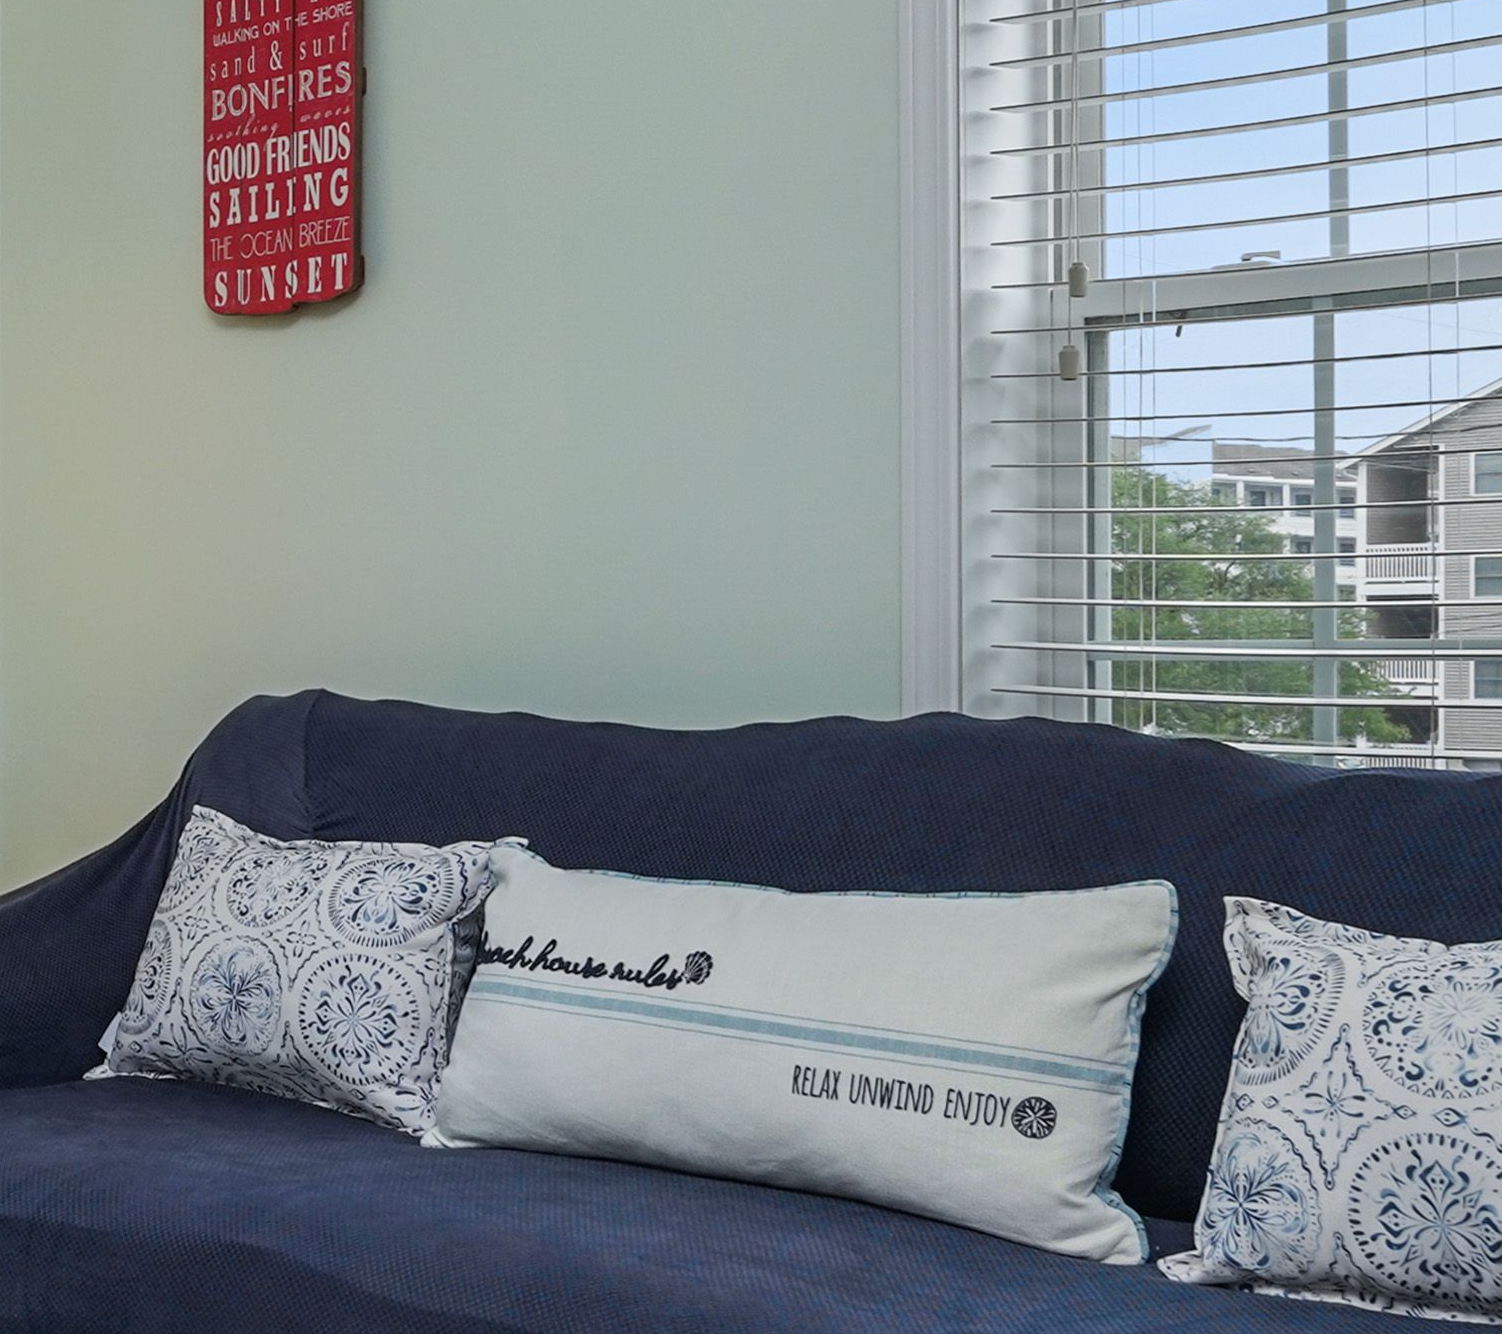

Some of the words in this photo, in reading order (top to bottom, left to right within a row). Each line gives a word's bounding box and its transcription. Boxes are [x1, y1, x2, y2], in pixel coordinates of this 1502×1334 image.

[209, 46, 256, 81] sand
[269, 40, 283, 71] &
[299, 22, 350, 61] surf
[212, 24, 259, 47] WALKING
[262, 21, 280, 37] ON
[284, 11, 308, 31] THE
[312, 1, 354, 25] SHORE
[210, 61, 352, 121] BONFIRES
[206, 141, 260, 185] GOOD
[266, 121, 351, 175] FRIENDS
[209, 167, 349, 229] SAILING
[210, 236, 234, 262] THE
[240, 227, 293, 259] OCEAN
[299, 216, 351, 248] BREEZE
[214, 253, 348, 308] SUNSET
[529, 939, 607, 979] house
[608, 953, 684, 990] rules
[791, 1065, 841, 1101] RELAX
[848, 1073, 934, 1115] UNWIND
[943, 1087, 1011, 1128] ENJOY
